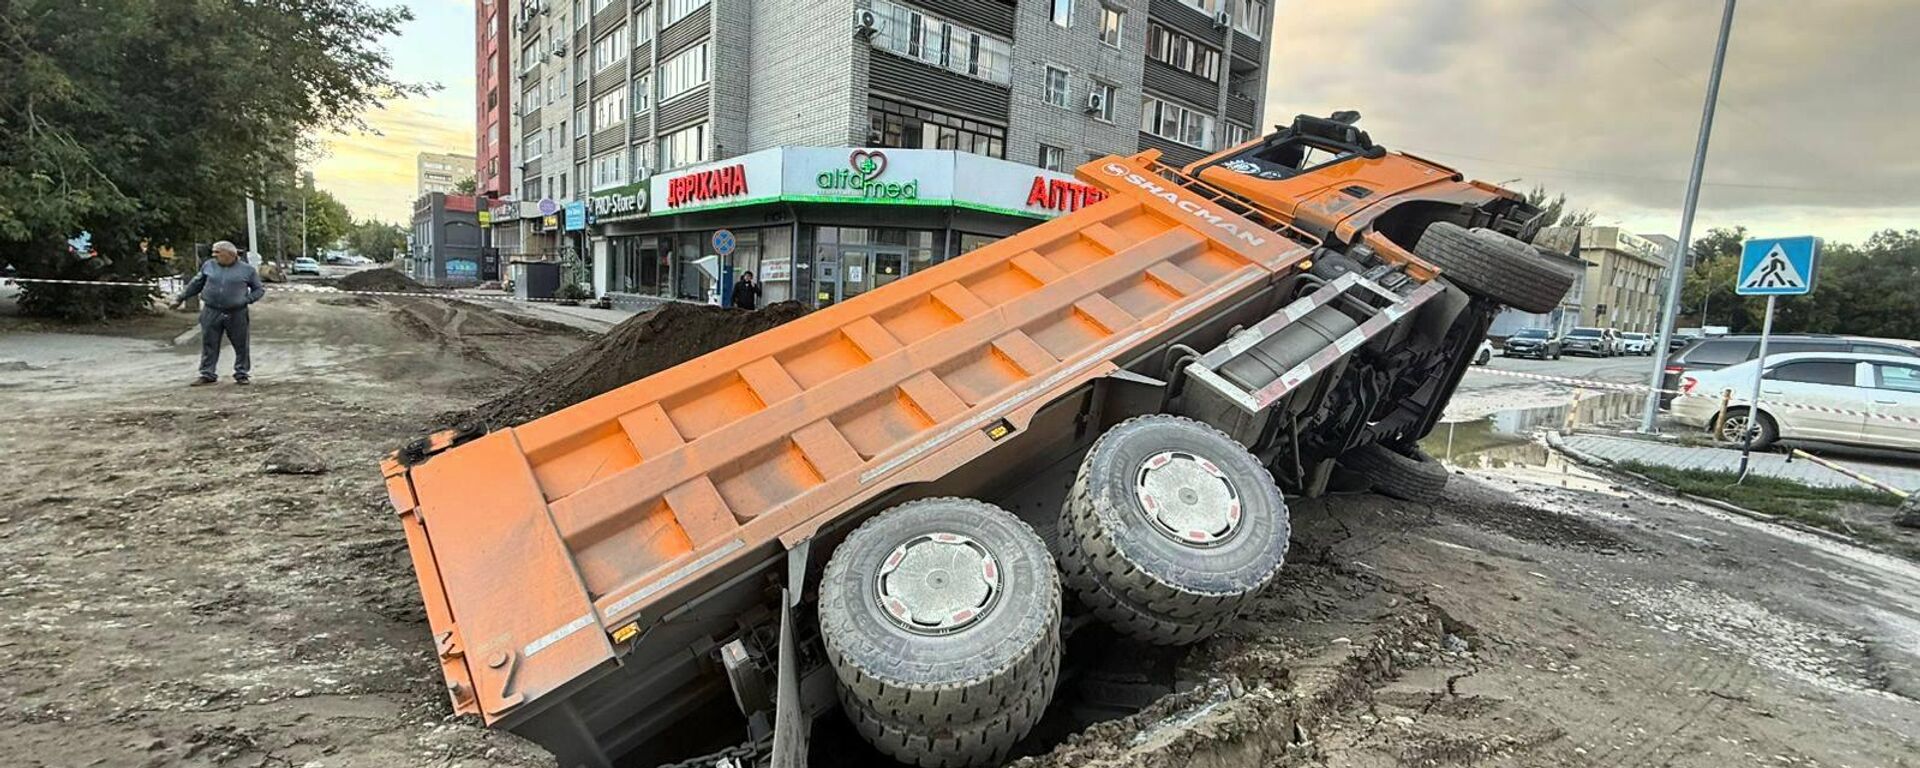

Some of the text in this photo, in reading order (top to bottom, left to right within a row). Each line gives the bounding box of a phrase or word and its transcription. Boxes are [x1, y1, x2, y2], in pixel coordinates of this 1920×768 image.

[667, 164, 748, 208] ДӘРІХАНА
[816, 168, 918, 199] alfa med
[1124, 173, 1265, 247] SHACMAN
